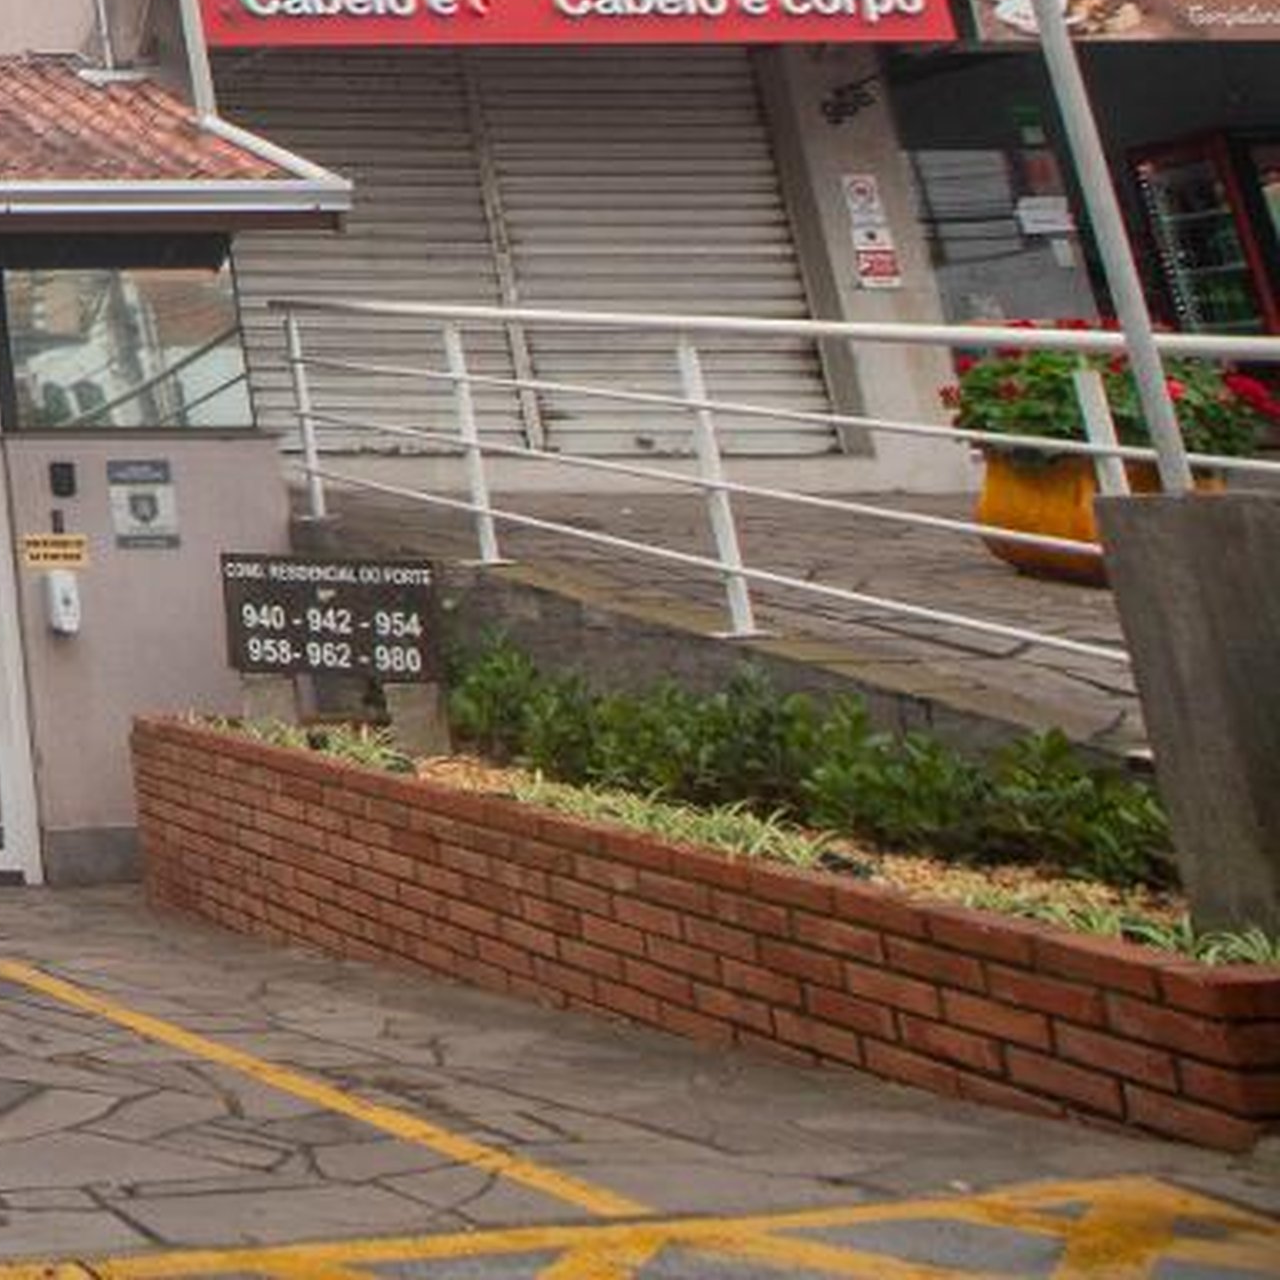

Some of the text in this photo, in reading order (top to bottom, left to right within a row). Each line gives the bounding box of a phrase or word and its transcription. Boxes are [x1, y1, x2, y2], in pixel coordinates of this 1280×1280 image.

[241, 603, 286, 629] 940
[306, 608, 352, 635] 942
[374, 611, 423, 637] 954
[306, 642, 352, 669] 962
[374, 645, 422, 672] 980
